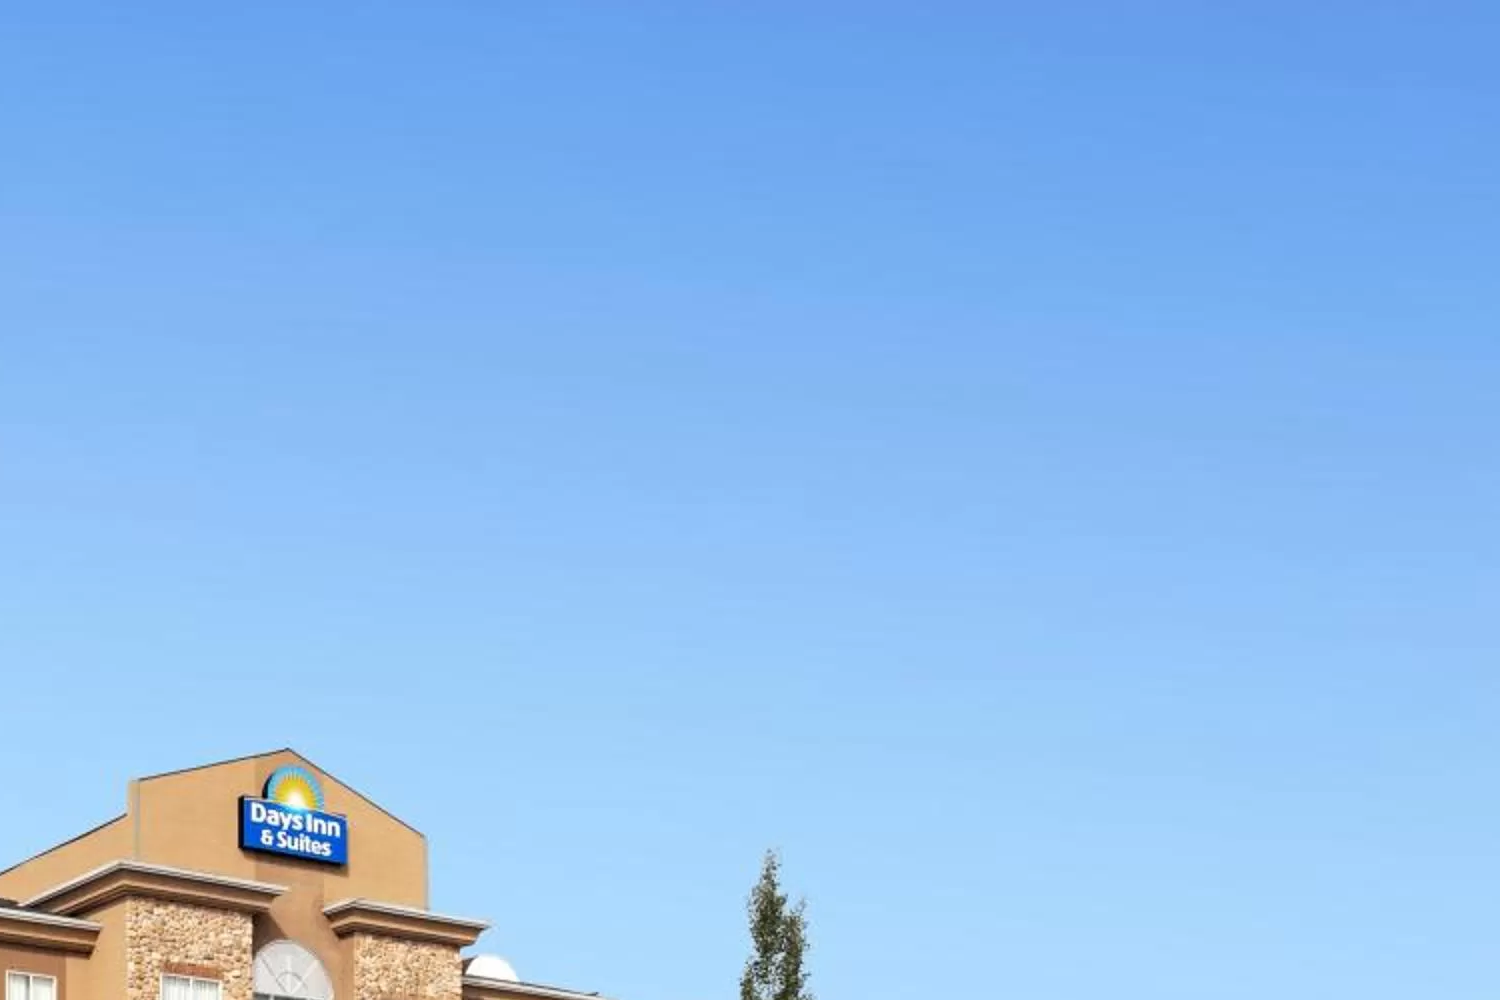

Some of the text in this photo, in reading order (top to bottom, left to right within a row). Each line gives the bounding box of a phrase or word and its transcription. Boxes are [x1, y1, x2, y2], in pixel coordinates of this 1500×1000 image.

[251, 802, 341, 837] Days Inn
[260, 829, 332, 857] & Suites
